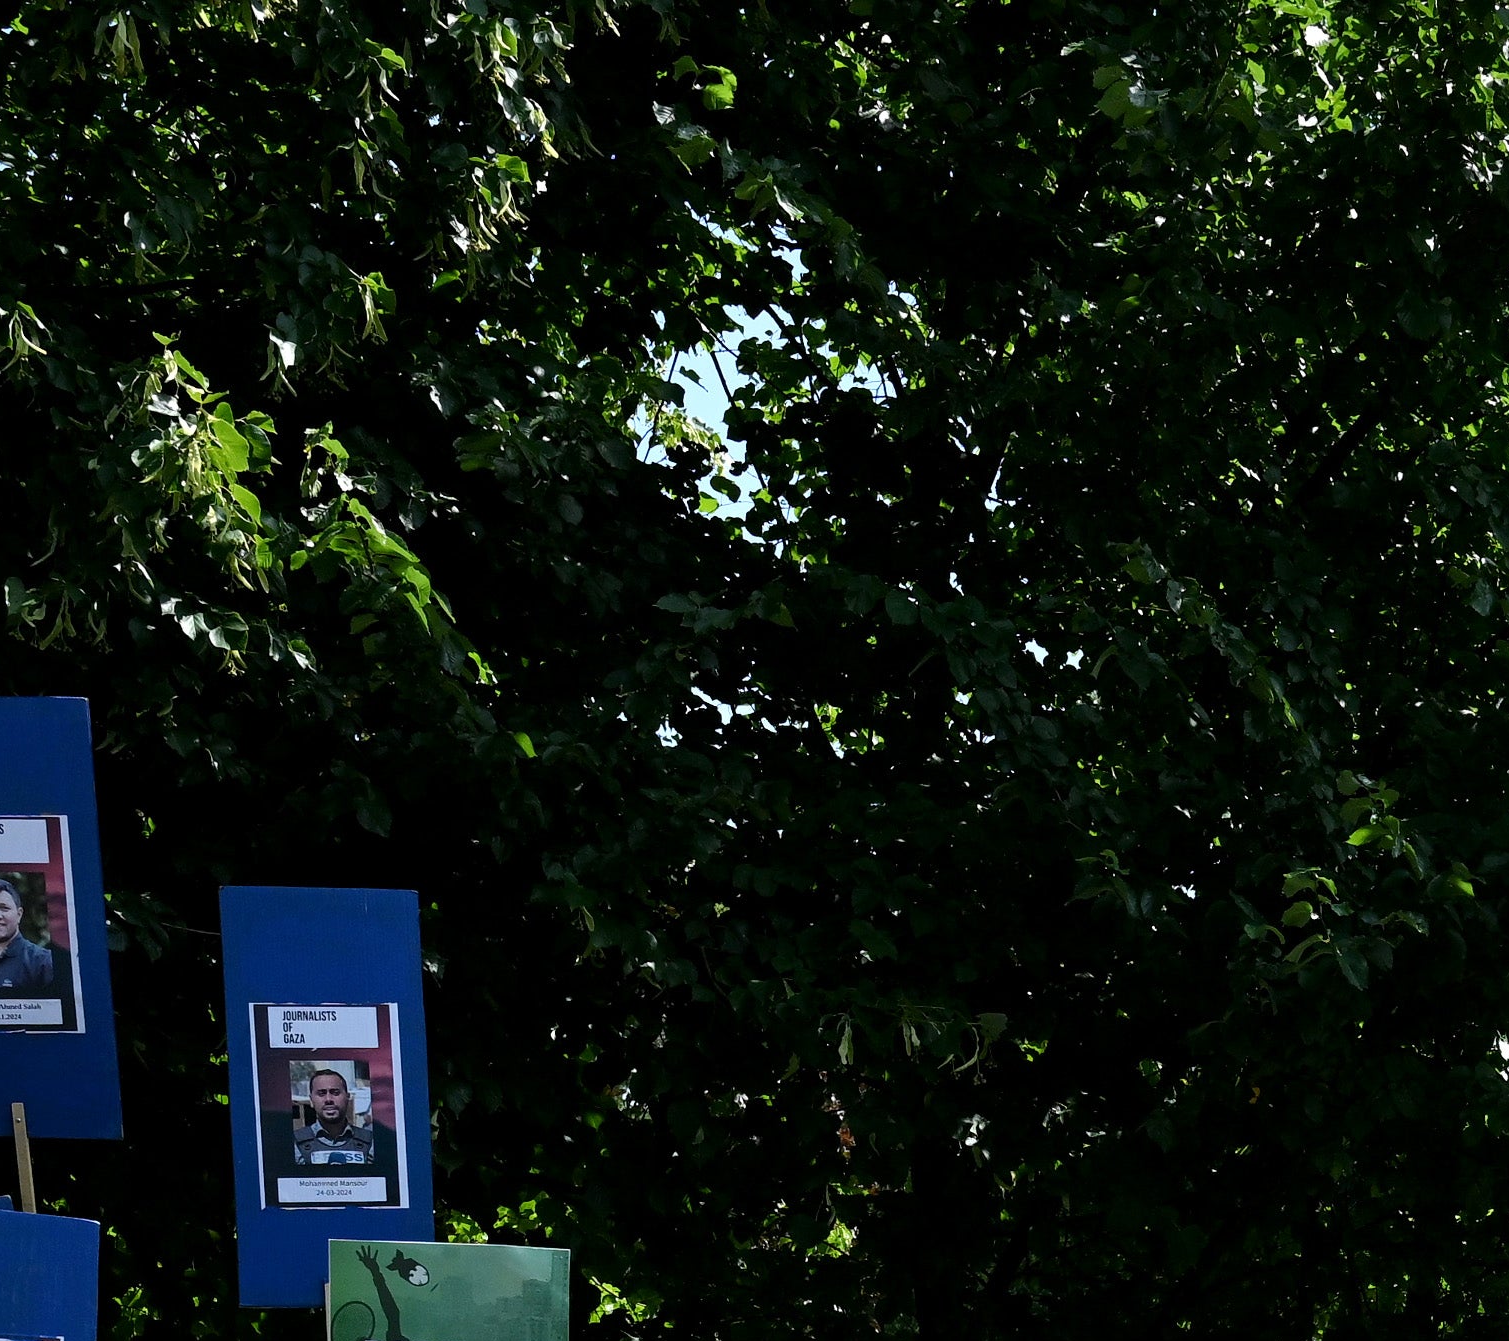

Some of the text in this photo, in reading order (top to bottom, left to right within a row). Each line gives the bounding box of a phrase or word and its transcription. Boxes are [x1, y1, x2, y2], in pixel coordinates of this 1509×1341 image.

[282, 1010, 337, 1021] JOURNALISTS
[283, 1022, 293, 1033] OF
[283, 1033, 306, 1044] GAZA
